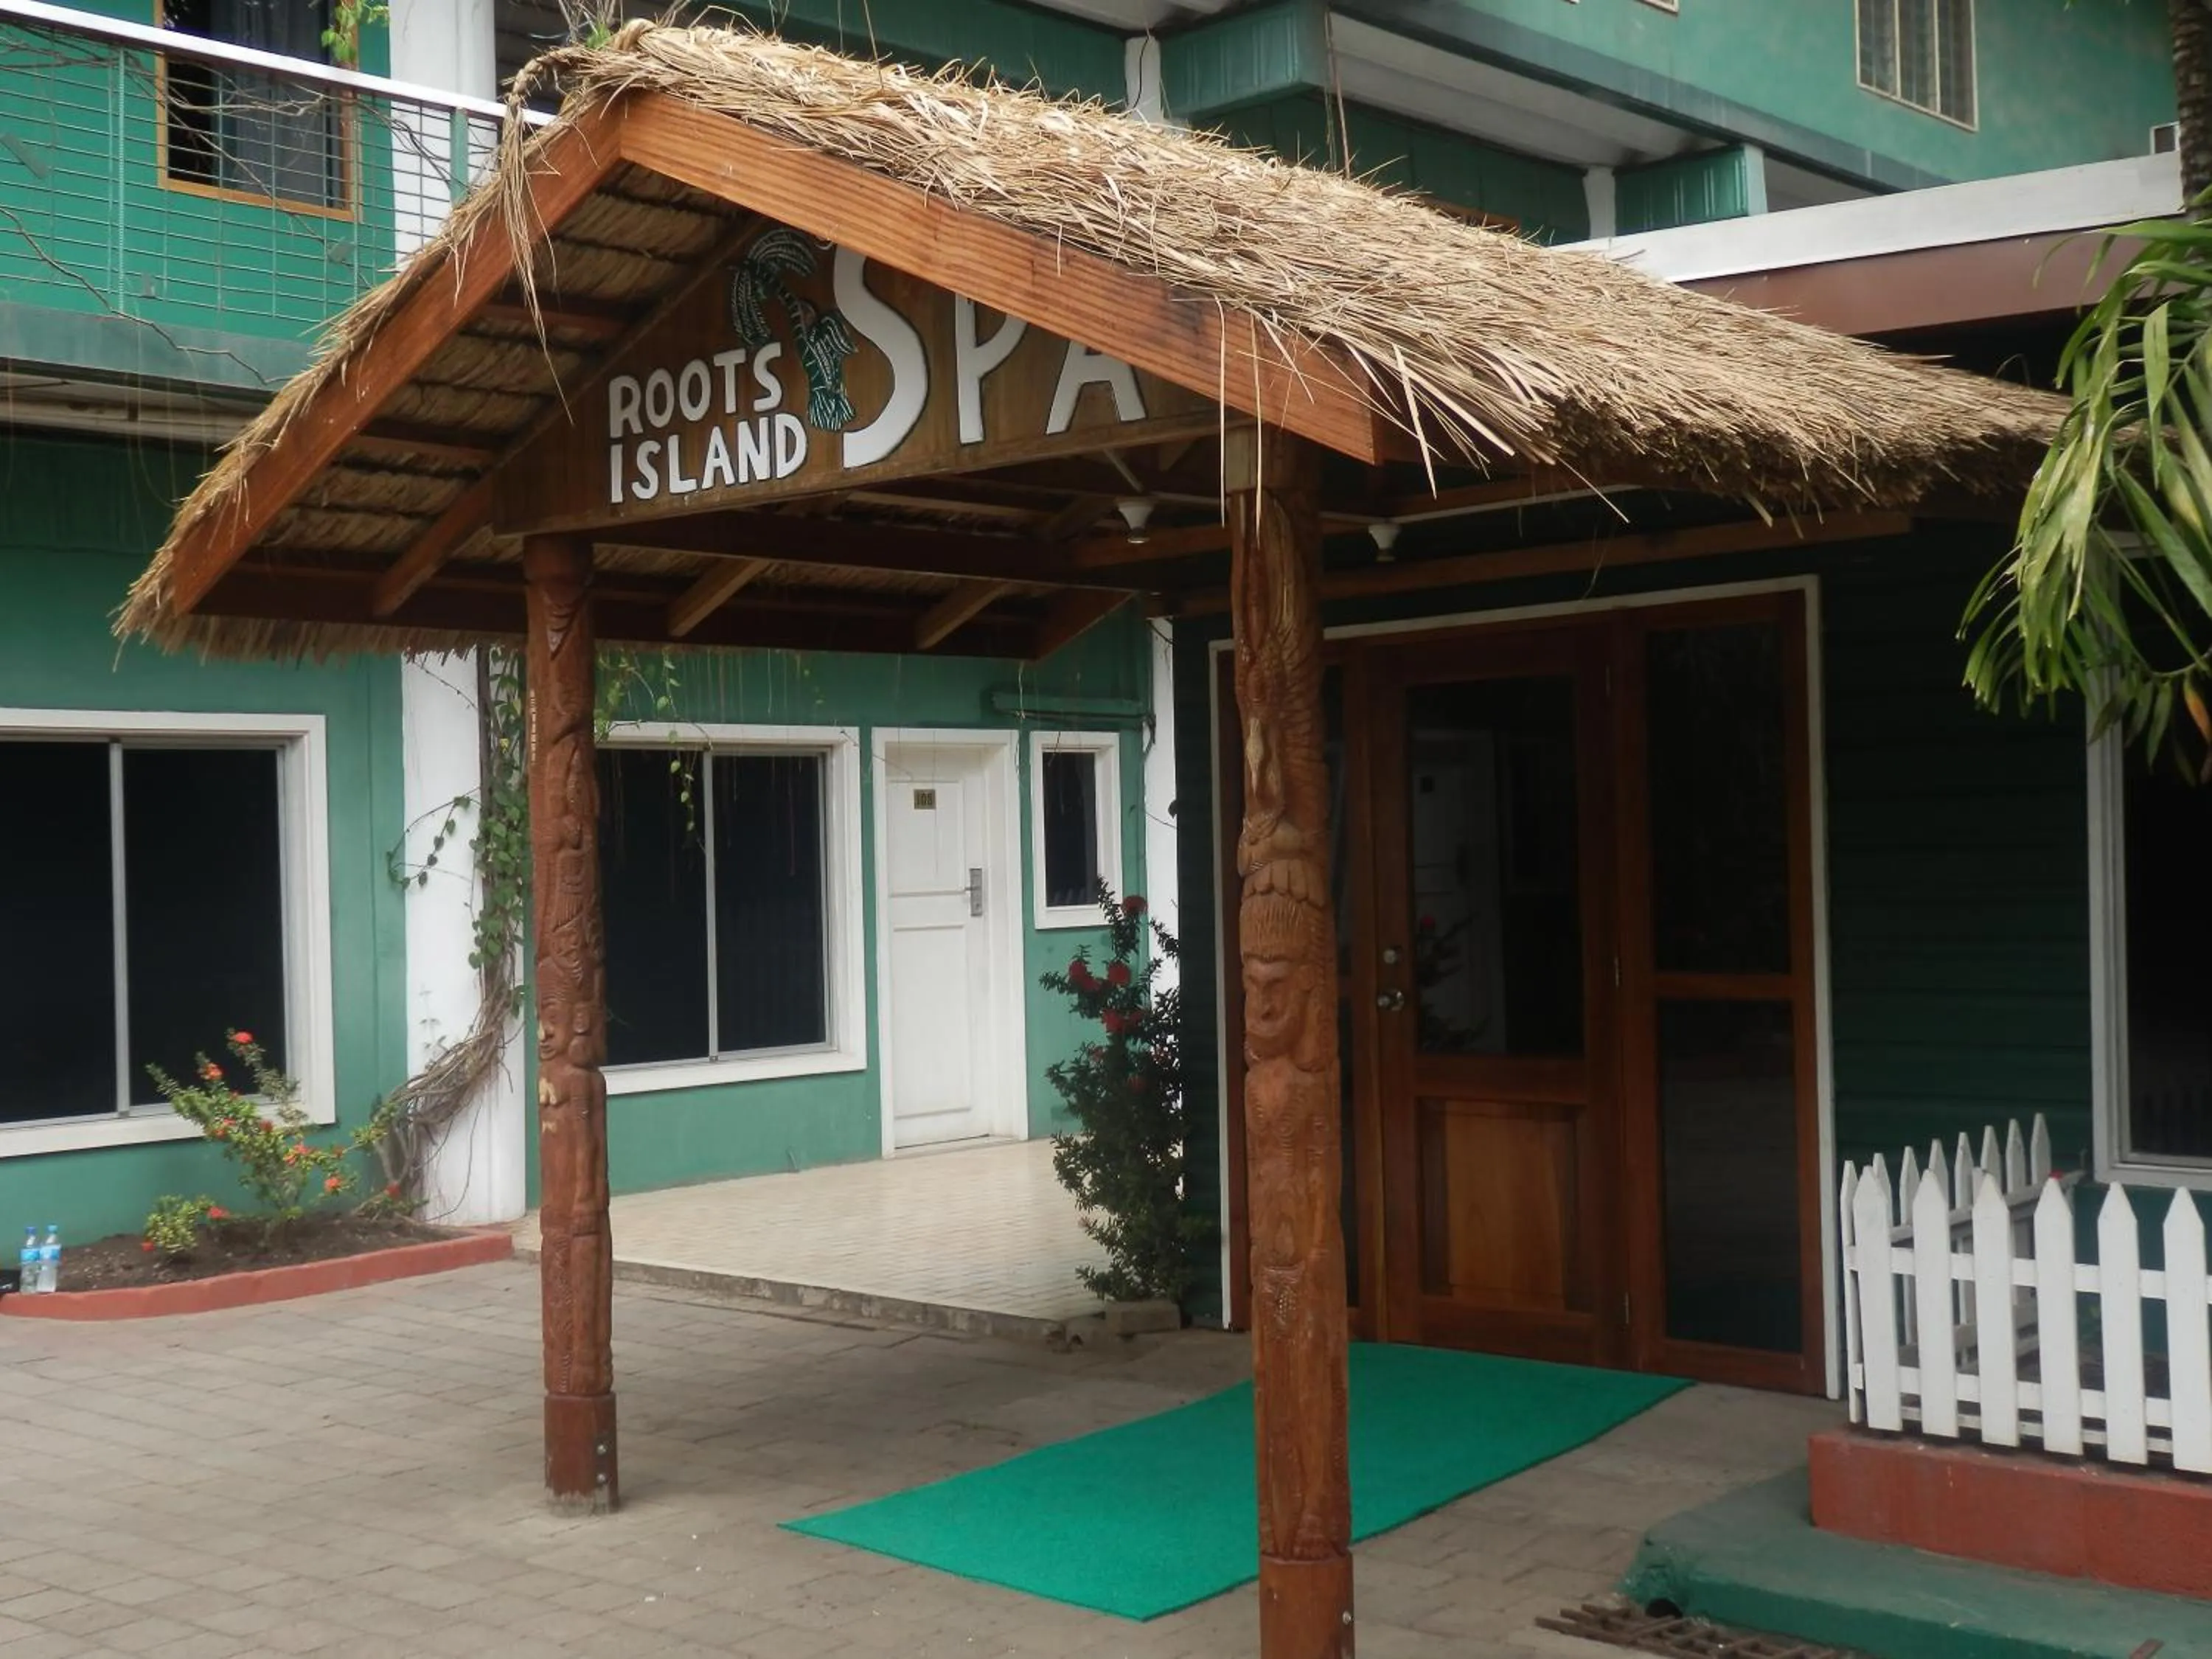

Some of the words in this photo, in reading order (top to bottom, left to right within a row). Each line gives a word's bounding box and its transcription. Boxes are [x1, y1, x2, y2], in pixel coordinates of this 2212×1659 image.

[608, 341, 783, 439] ROOTS
[833, 245, 1147, 468] SPA
[609, 411, 807, 504] ISLAND
